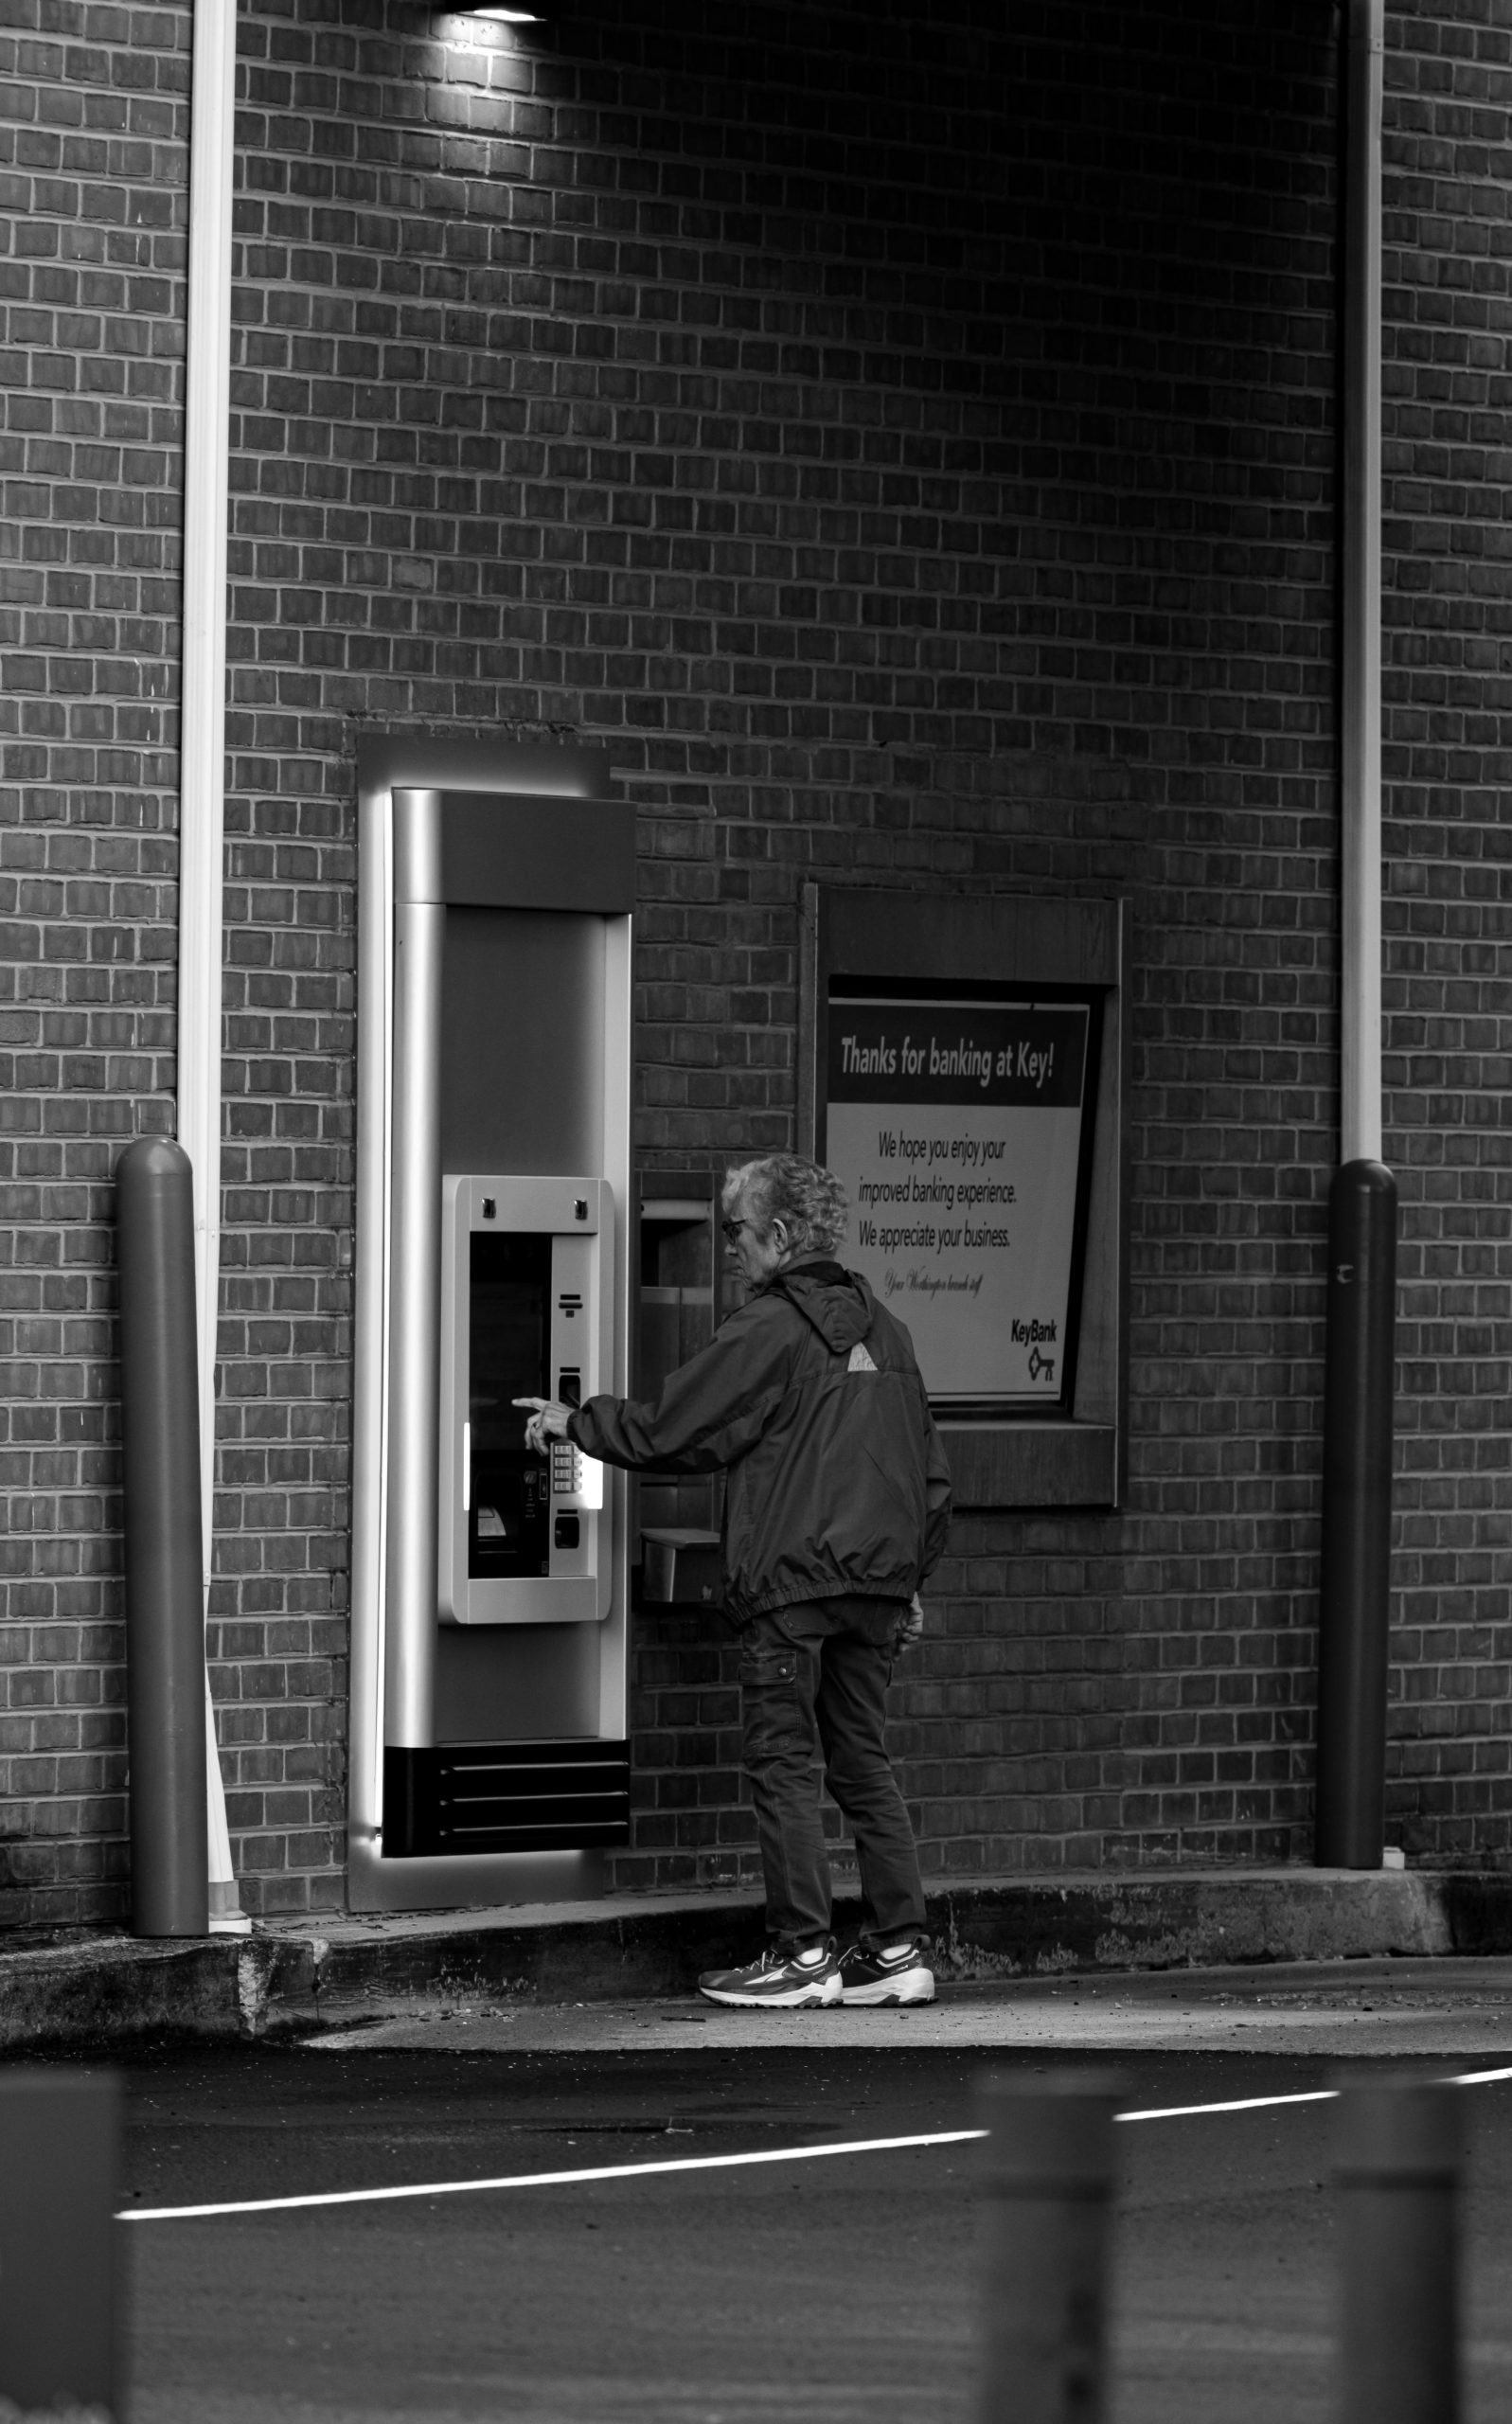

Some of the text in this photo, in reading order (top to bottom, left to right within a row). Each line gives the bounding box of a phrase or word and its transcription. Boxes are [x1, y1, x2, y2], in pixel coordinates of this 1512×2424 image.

[842, 1035, 1054, 1088] Thanks for banking at Key!
[879, 1131, 1006, 1167] We hope you enjoy your
[859, 1175, 1017, 1210] improved banking experience.
[859, 1220, 1010, 1255] We appreciate your business.
[1011, 1318, 1058, 1348] KeyBank
